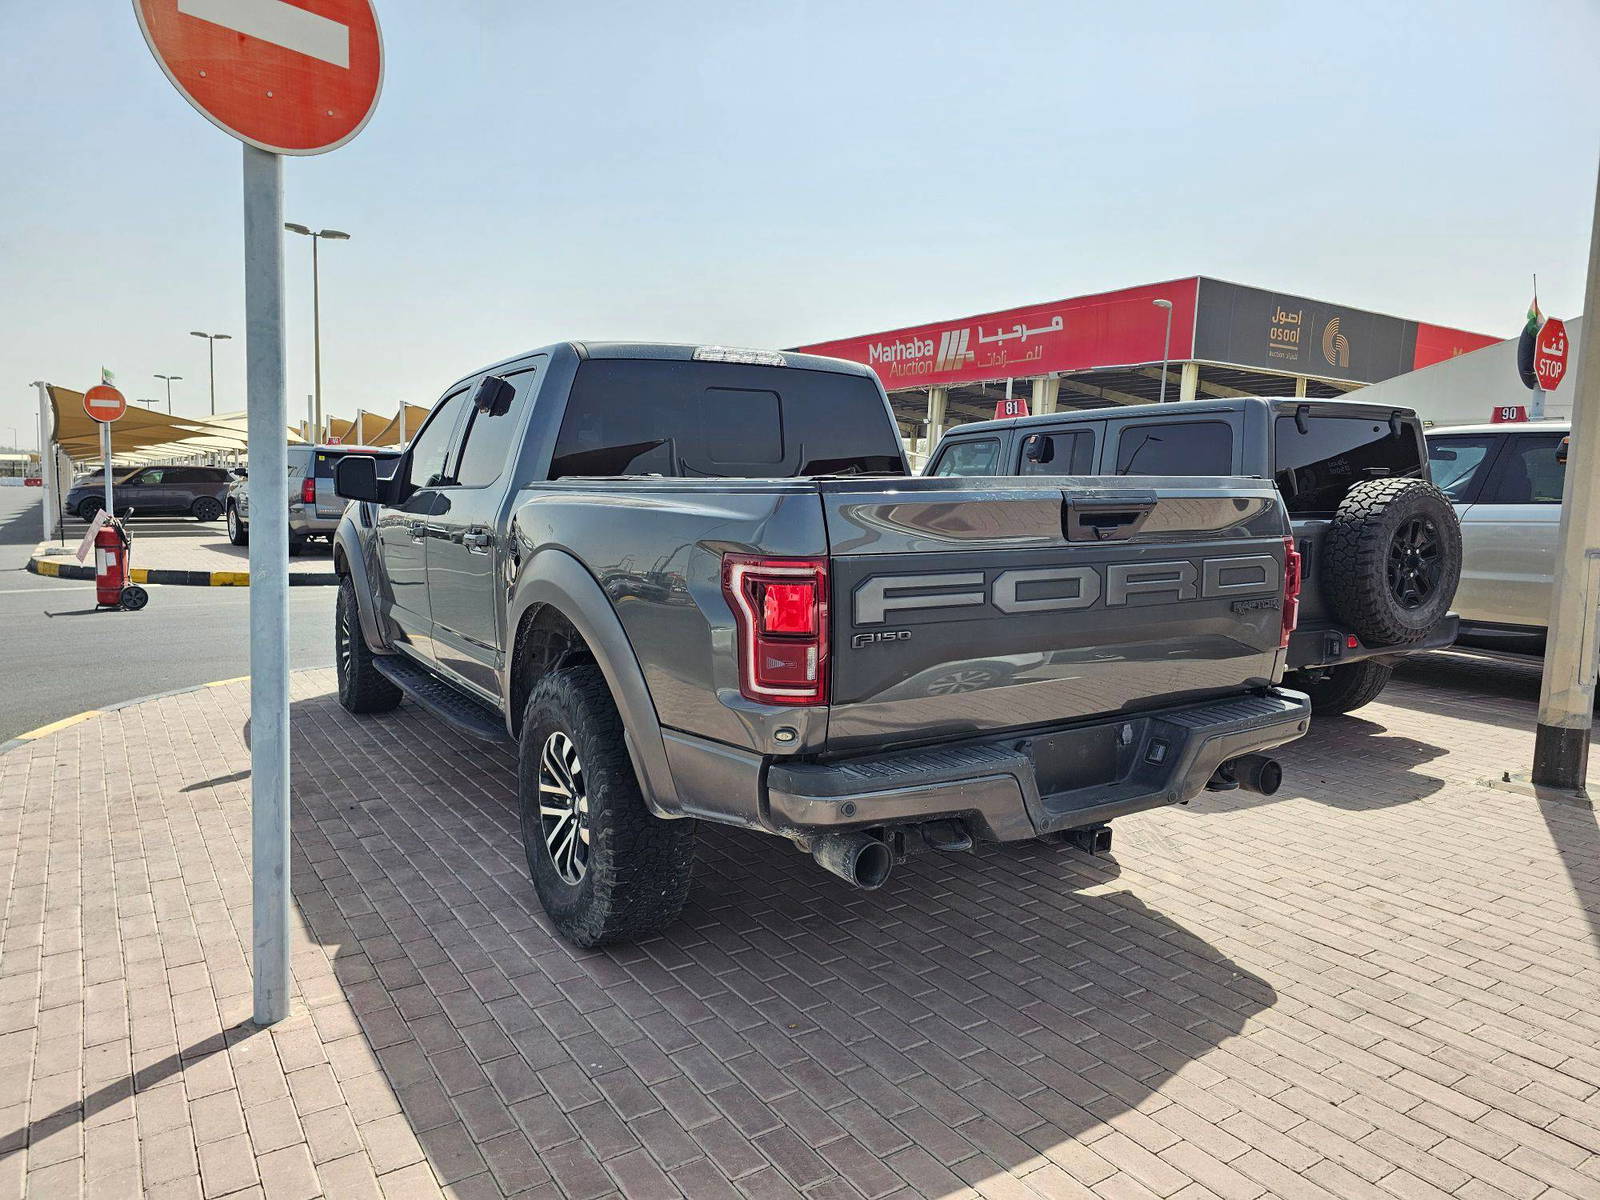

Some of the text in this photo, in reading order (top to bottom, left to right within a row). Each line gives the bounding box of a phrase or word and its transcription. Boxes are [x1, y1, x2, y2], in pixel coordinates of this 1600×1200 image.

[978, 315, 1064, 346] مرحبا
[869, 337, 934, 364] Marhaba
[1542, 331, 1564, 356] قف
[889, 358, 933, 377] Auction
[1539, 358, 1562, 379] STOP
[1006, 401, 1018, 415] 81
[1502, 407, 1517, 420] 90
[854, 554, 1280, 626] FORD
[851, 631, 912, 649] F150
